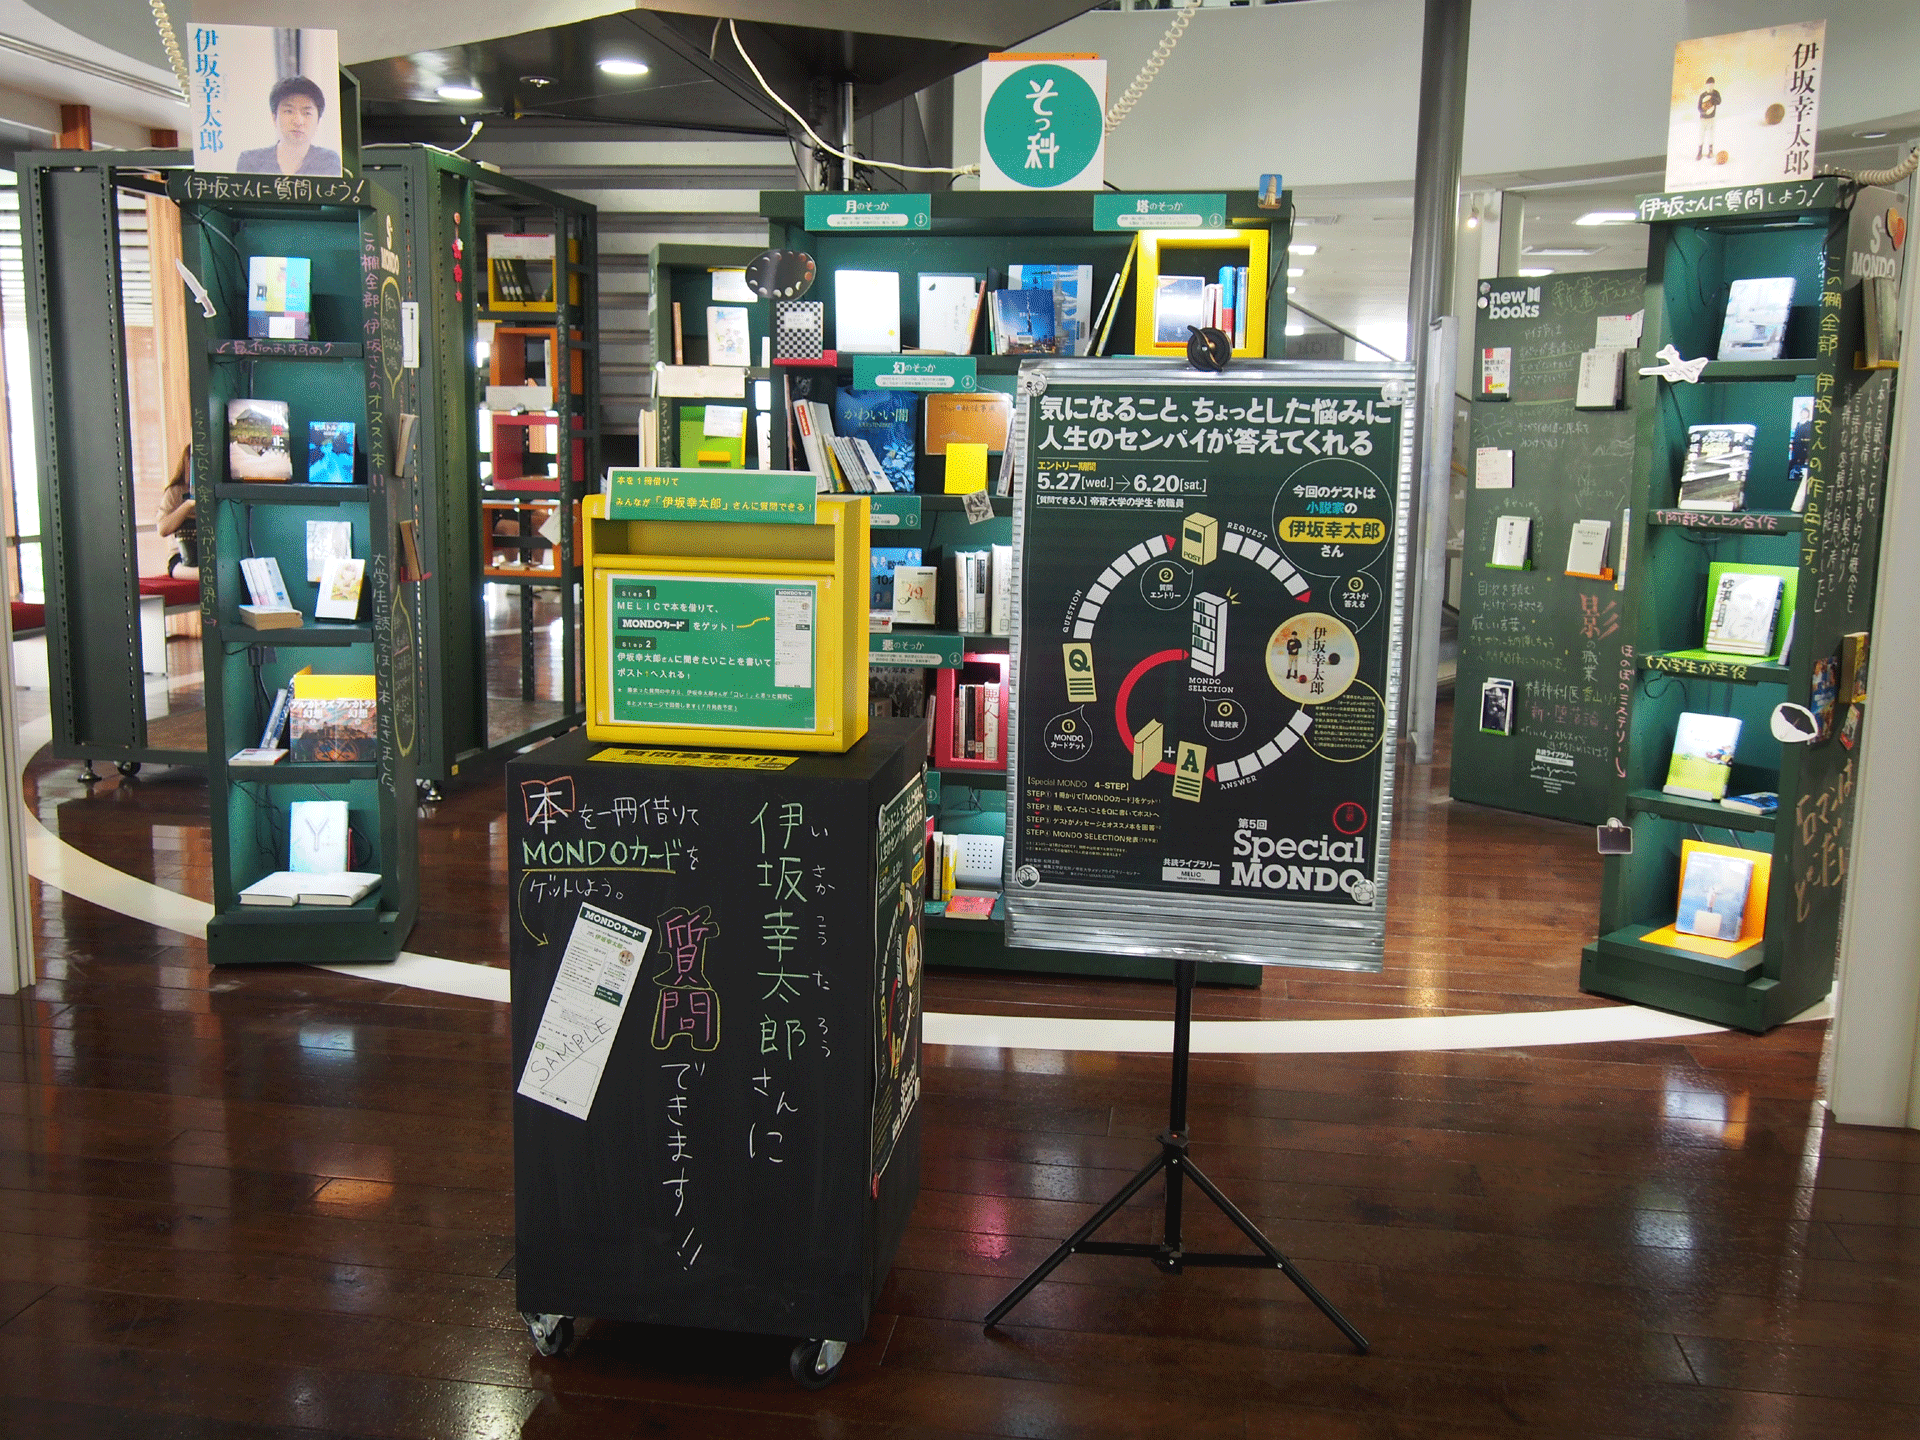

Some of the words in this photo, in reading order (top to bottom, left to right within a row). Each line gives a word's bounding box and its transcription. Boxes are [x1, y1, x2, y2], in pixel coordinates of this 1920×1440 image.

[194, 28, 224, 153] 伊坂幸太郎
[1784, 42, 1819, 176] 伊坂幸太郎
[1025, 78, 1060, 169] そっ科
[183, 175, 365, 203] 伊坂さんに質問しよう!
[845, 199, 890, 213] 月のそっか
[1136, 199, 1184, 213] 塔のそっか
[1639, 182, 1824, 221] 伊坂さんに質問しよう!
[1489, 290, 1526, 304] new
[1489, 303, 1540, 319] books
[893, 361, 936, 374] 幻のそっか
[844, 408, 909, 423] かわいい闇
[1040, 396, 1391, 424] 気になること、ちょっとした悩みに
[1038, 425, 1374, 456] 人生のセンパイが答えてくれる
[1037, 461, 1097, 471] エントリー期間
[1293, 485, 1376, 499] 今回のゲストは
[1036, 495, 1088, 505] [質問できる人]
[1090, 497, 1184, 508] 帝京大学の学生・教職員
[1306, 501, 1358, 514] 小説家の
[1666, 512, 1778, 530] 阿部さんとの合作
[1227, 521, 1268, 541] REQUEST
[1289, 520, 1380, 539] 伊坂幸太郎
[1184, 551, 1201, 562] POST
[1321, 545, 1344, 558] さん
[1342, 592, 1369, 600] ゲストが
[1344, 600, 1366, 608] 答える
[1062, 589, 1083, 633] QUESTION
[622, 619, 685, 630] MONDOカード
[617, 652, 772, 667] 伊坂幸太郎さんに聞きたいことを書いて
[1069, 649, 1090, 672] Q
[1310, 626, 1328, 695] 伊坂幸太郎
[617, 669, 643, 677] ポスト
[1655, 657, 1748, 680] 大学生が主役
[1188, 677, 1221, 685] MONDO
[1188, 685, 1234, 693] SELECTION
[1210, 720, 1239, 728] 結果発表
[1050, 742, 1086, 750] カードゲット
[1054, 734, 1084, 742] MONDO
[1181, 749, 1199, 774] A
[1057, 779, 1088, 788] MONDO
[1220, 775, 1257, 791] ANSWER
[529, 787, 700, 834] 本を一冊借りて
[1238, 818, 1268, 831] 第5回
[1052, 830, 1083, 839] MONDO
[1233, 829, 1365, 863] Special
[522, 838, 700, 871] MONDOカードを
[1163, 858, 1220, 869] 共読ライブラリー
[1231, 862, 1367, 894] MONDO
[530, 877, 624, 903] ゲットしよう。
[584, 909, 642, 938] MONDOカード
[749, 801, 810, 1163] 伊坂幸太郎さんに
[530, 1017, 612, 1082] SAMPLE
[660, 914, 711, 1271] 質問できます!!
